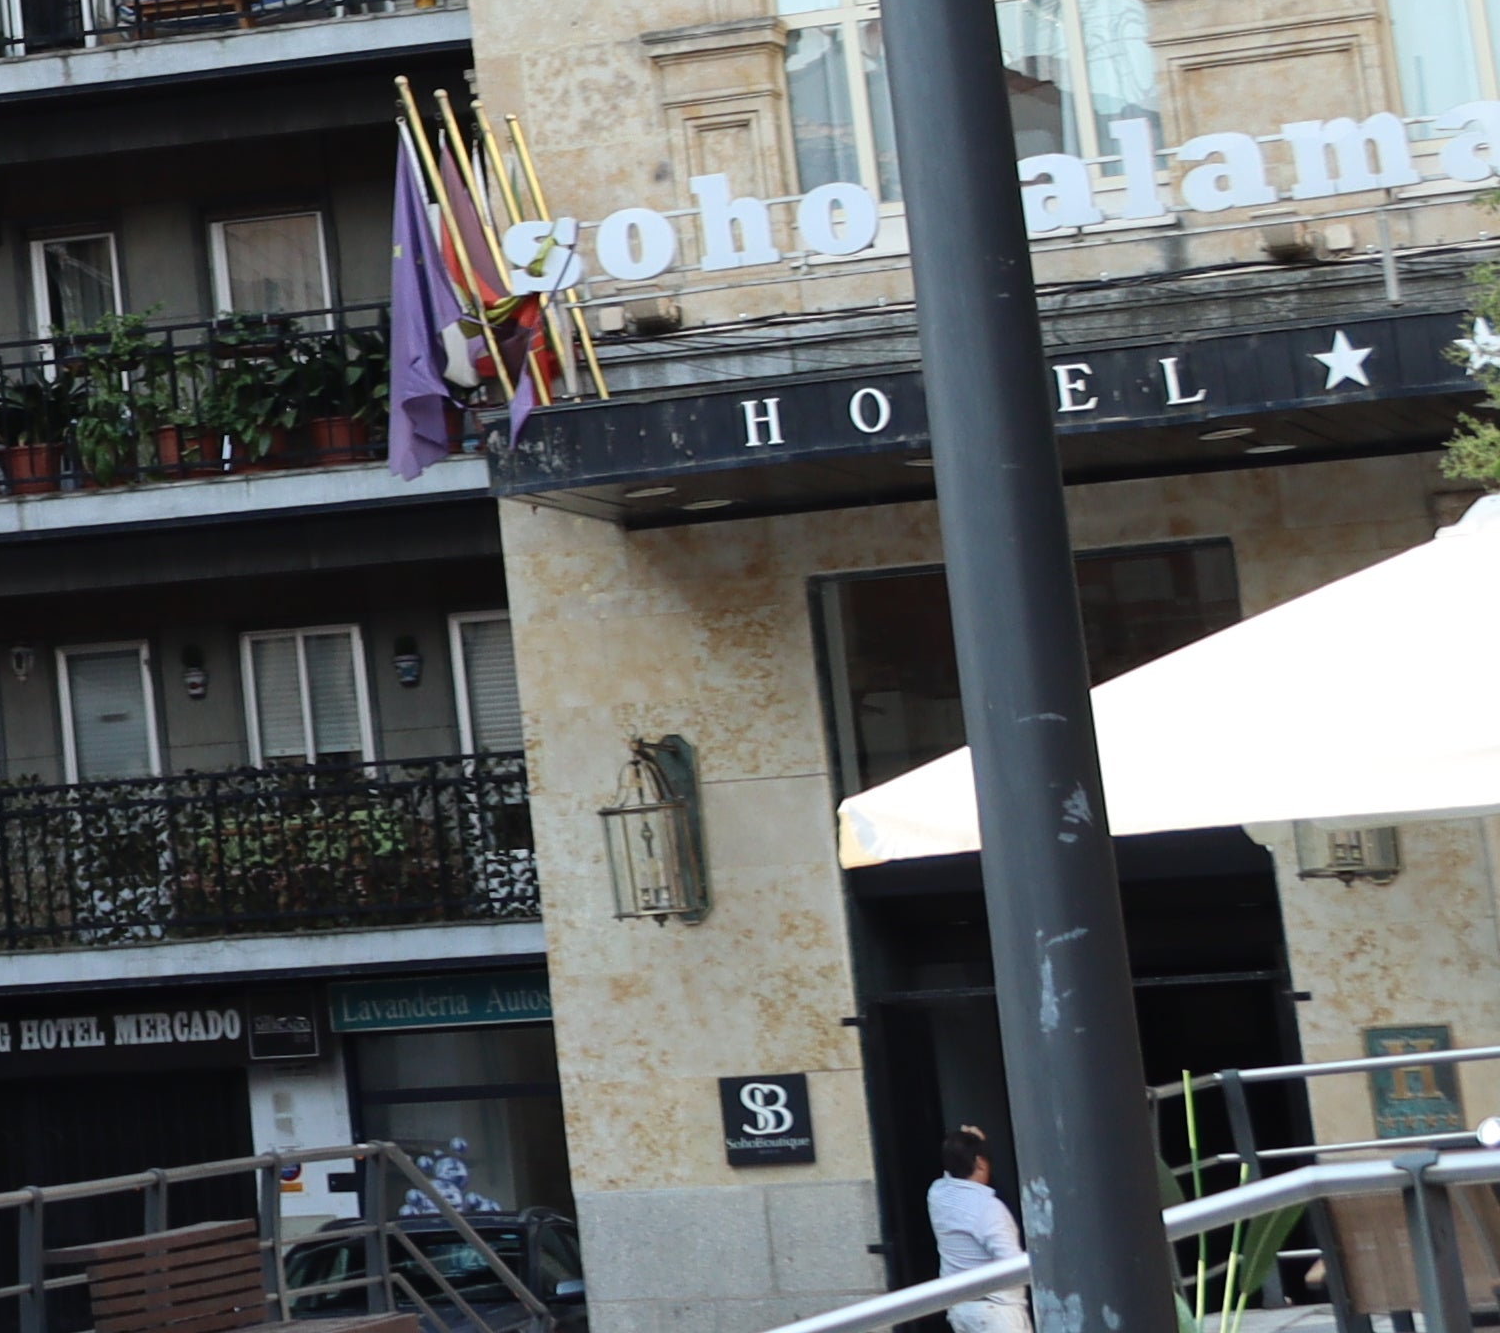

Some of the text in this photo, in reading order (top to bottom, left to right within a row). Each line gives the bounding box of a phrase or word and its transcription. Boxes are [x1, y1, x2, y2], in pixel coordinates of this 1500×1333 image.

[501, 171, 880, 294] soho
[741, 356, 1208, 448] HOEL
[19, 1016, 105, 1051] HOTEL
[113, 1009, 242, 1046] MERCADO
